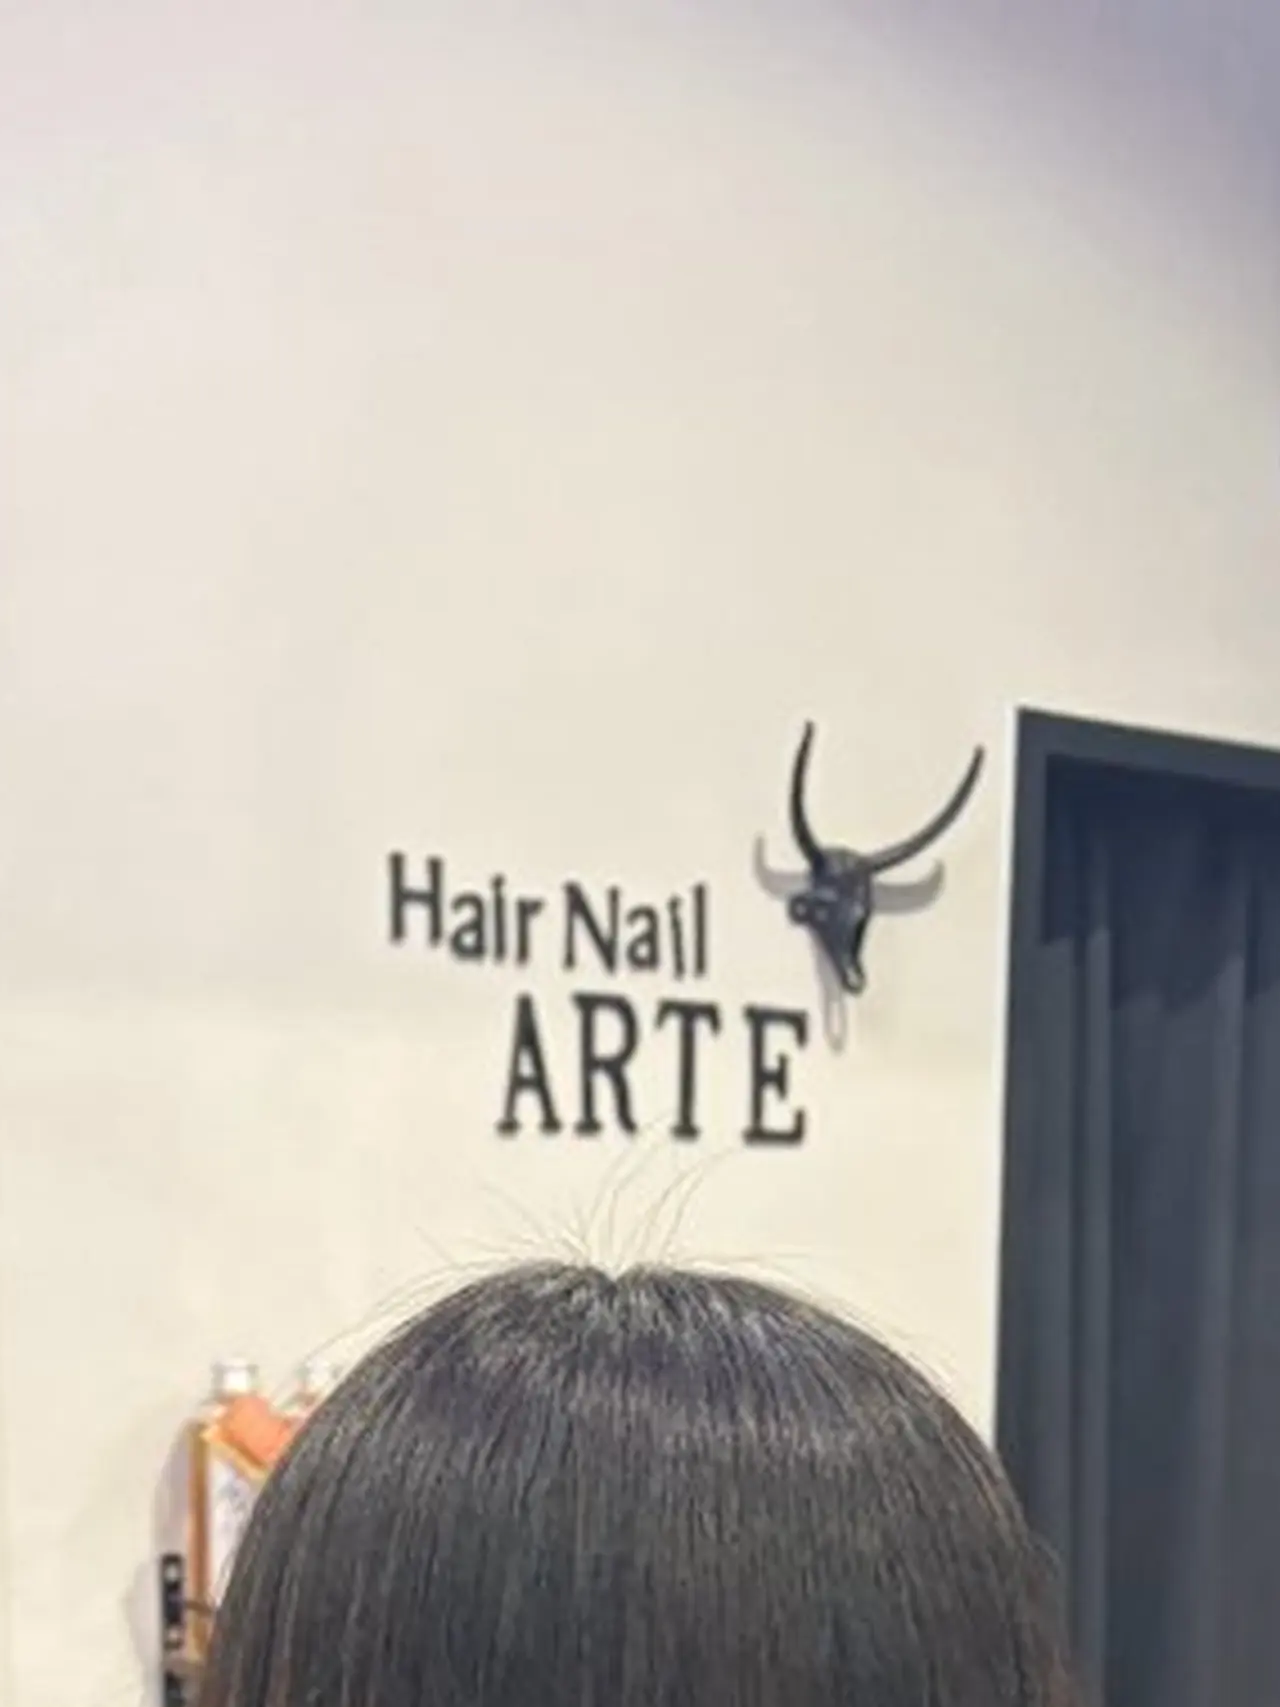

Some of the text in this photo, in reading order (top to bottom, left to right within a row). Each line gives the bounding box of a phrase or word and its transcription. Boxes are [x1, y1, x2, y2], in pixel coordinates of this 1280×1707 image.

[387, 849, 708, 978] Hair Nail
[495, 990, 808, 1146] ARTE
